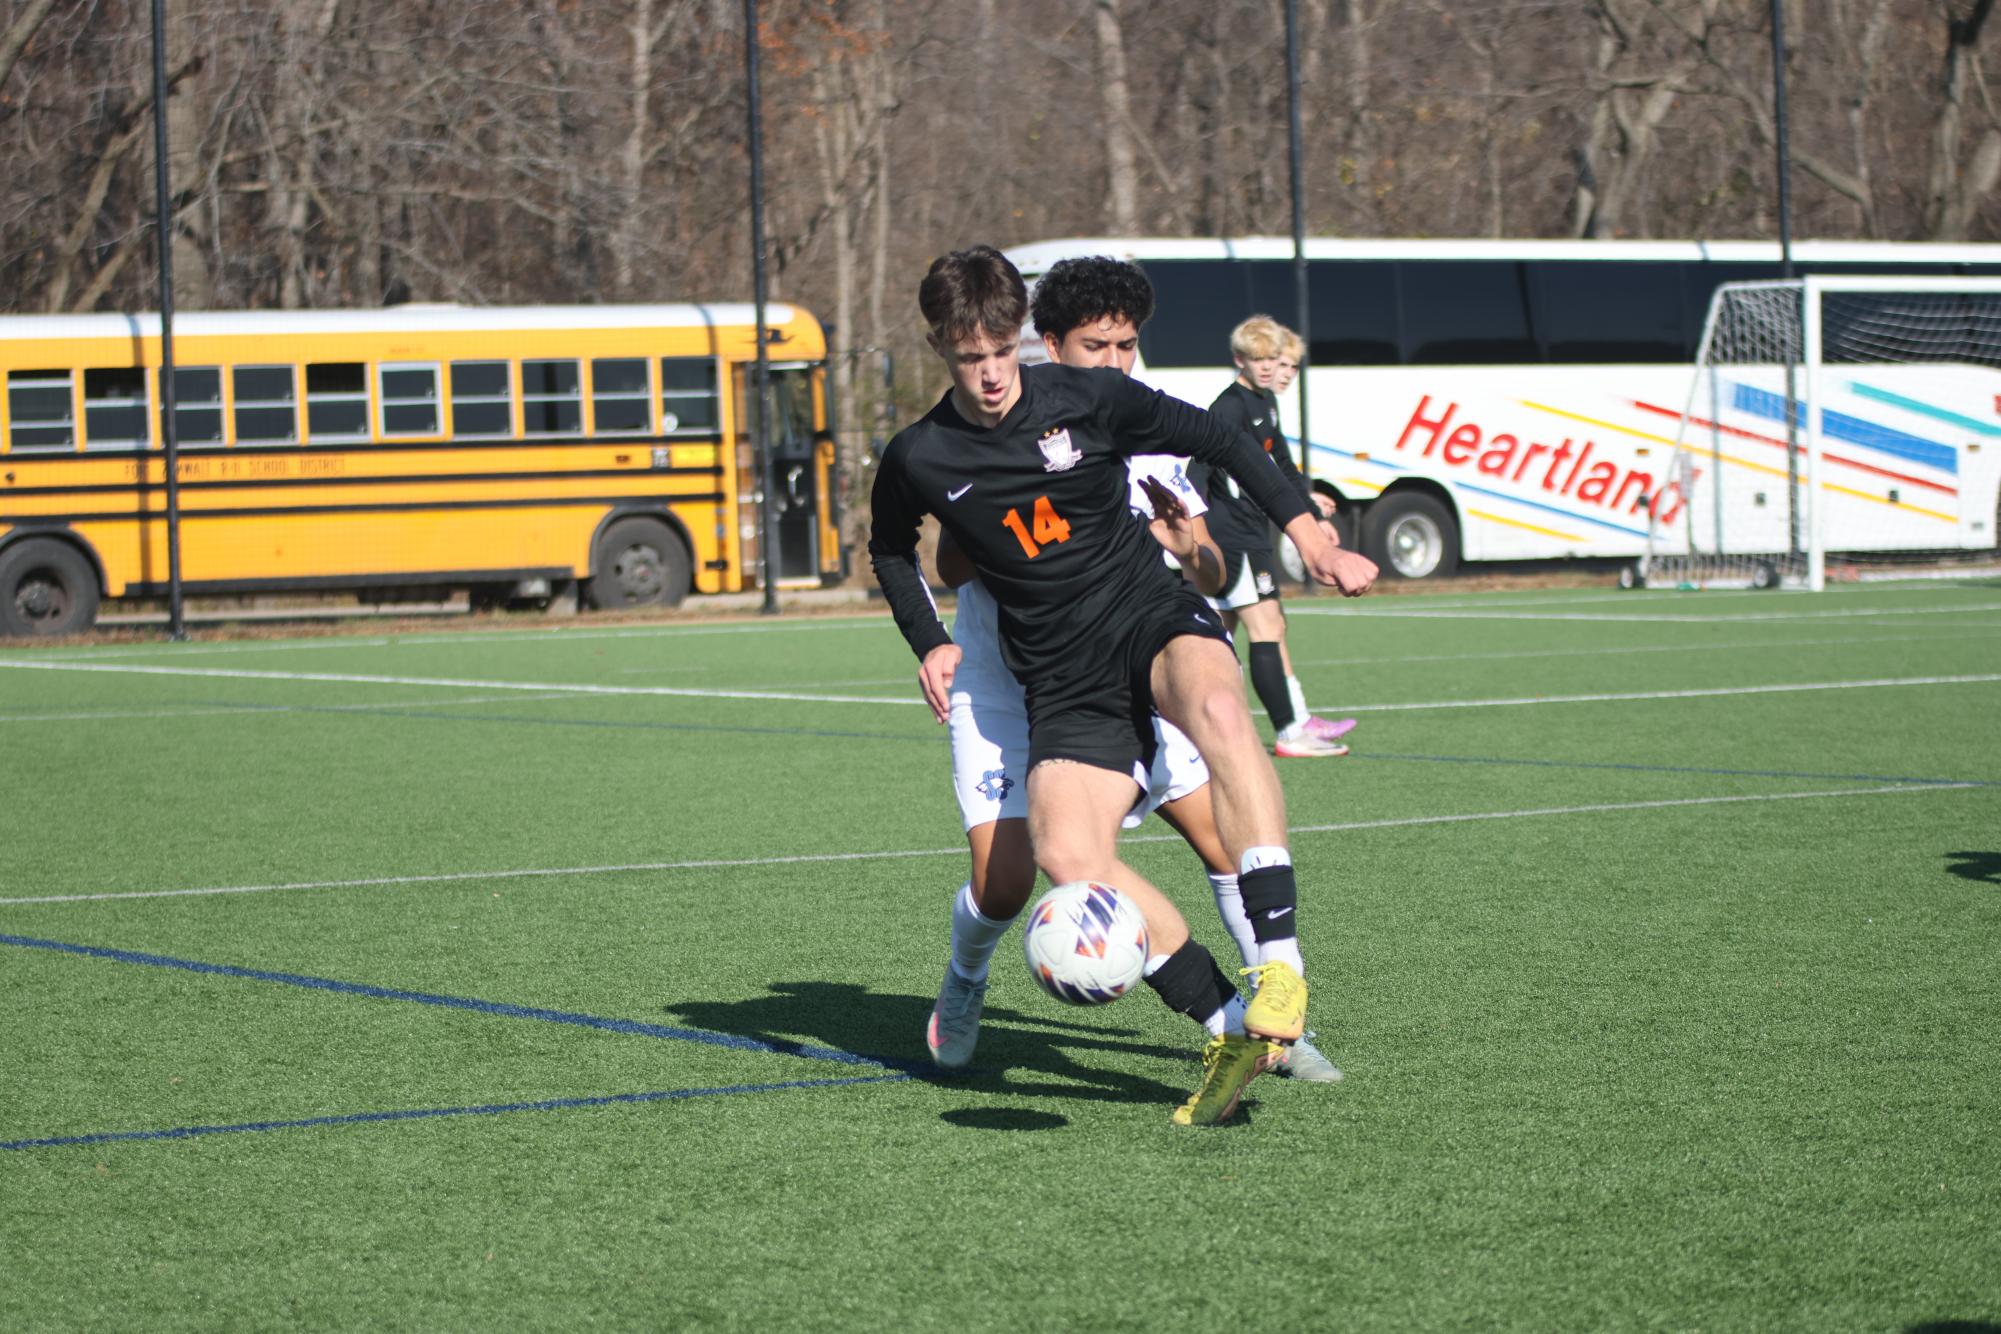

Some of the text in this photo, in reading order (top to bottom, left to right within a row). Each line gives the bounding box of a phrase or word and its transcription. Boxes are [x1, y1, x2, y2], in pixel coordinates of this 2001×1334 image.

[249, 459, 290, 475] SCHOOL
[299, 457, 346, 474] DISTRICT
[1002, 495, 1071, 559] 14
